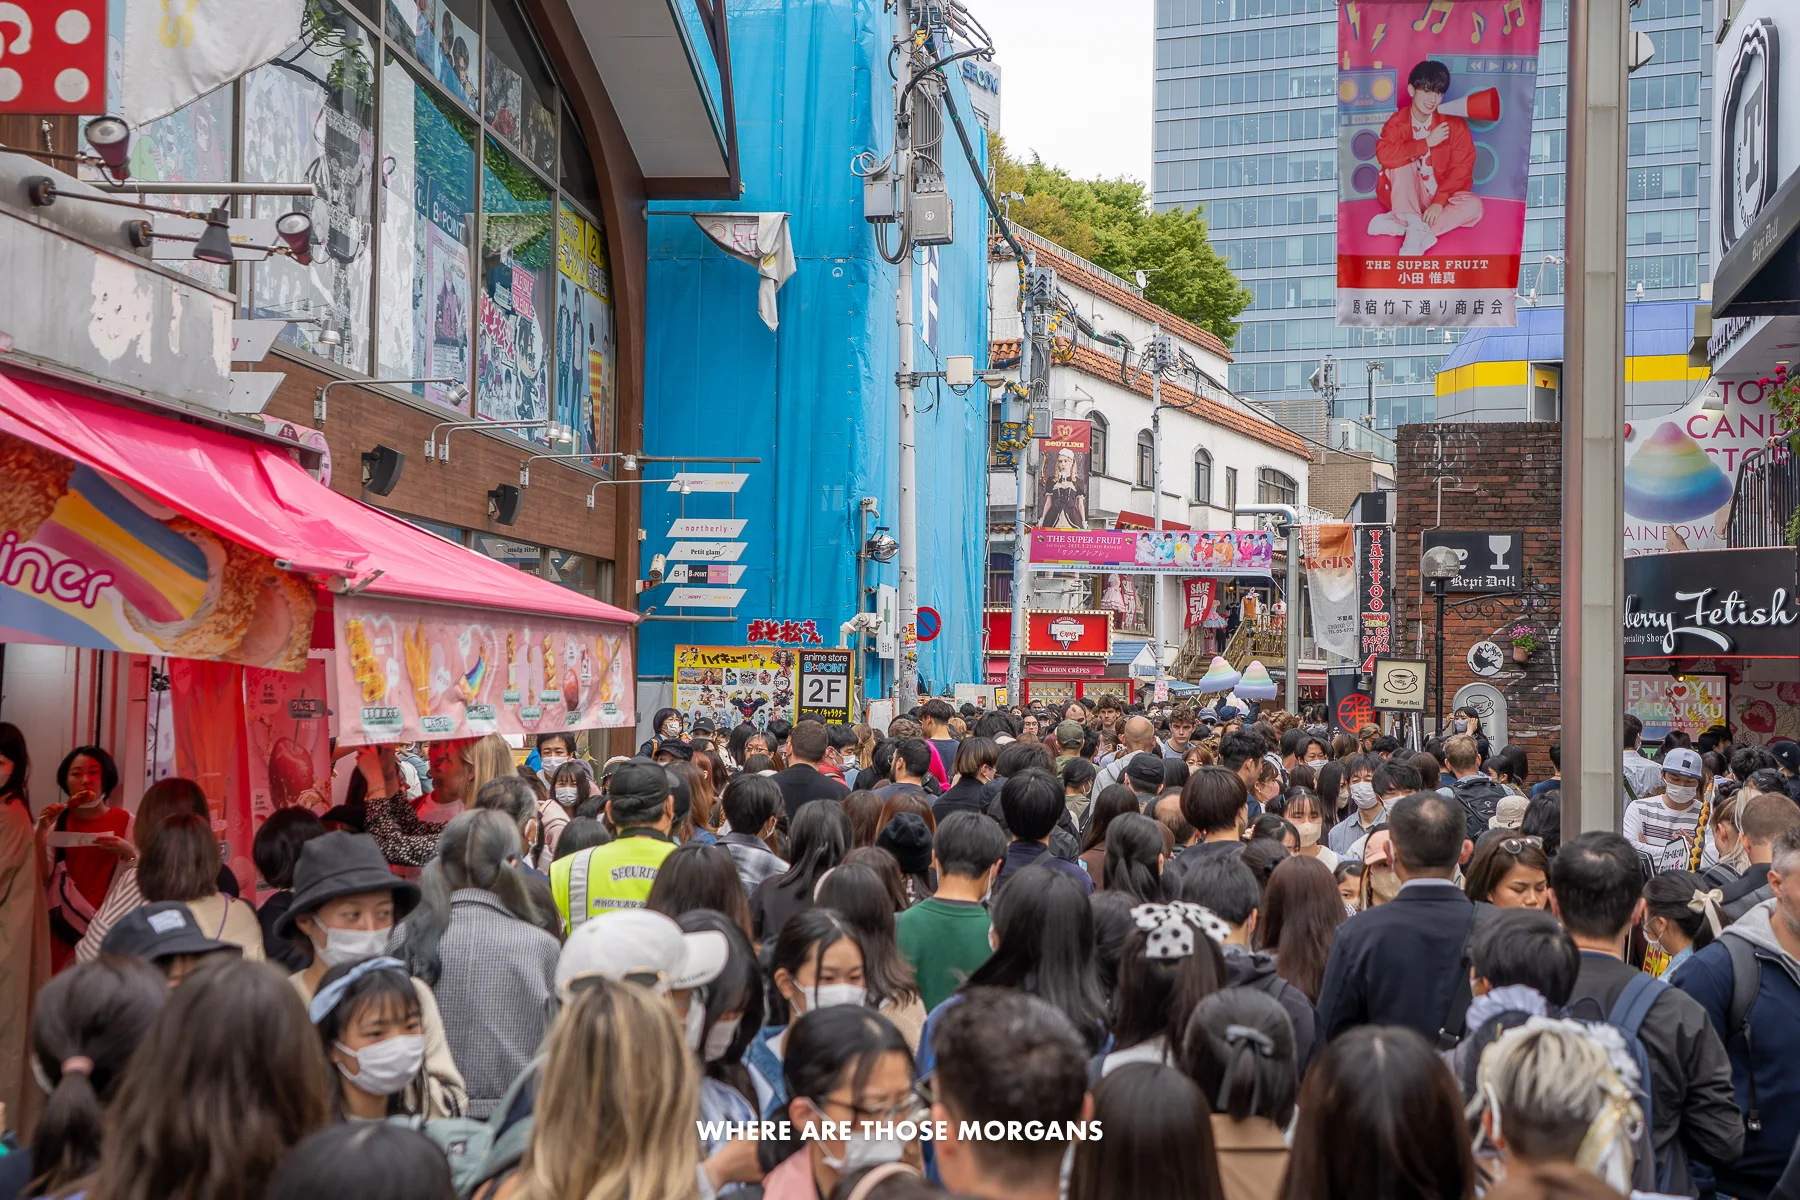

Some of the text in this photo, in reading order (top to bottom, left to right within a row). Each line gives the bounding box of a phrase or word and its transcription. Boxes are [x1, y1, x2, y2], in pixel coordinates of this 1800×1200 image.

[963, 60, 998, 95] SECOM
[1366, 259, 1489, 270] THE SUPER FRUIT
[1398, 272, 1424, 284] 小田
[1353, 299, 1503, 315] 原宿竹下通り商店会
[685, 524, 728, 533] northerly
[1624, 525, 1714, 541] AINBOW
[1047, 535, 1065, 543] THE
[705, 549, 720, 557] glam
[1190, 582, 1210, 595] SALE
[1675, 587, 1797, 626] Fetish
[746, 618, 823, 645] おそ松さん
[1375, 627, 1389, 636] 03
[1362, 636, 1389, 645] 3497
[1624, 633, 1664, 645] peciality Shop
[804, 653, 848, 662] anime store
[808, 678, 842, 703] 2F
[1627, 702, 1722, 719] HARAJUKU
